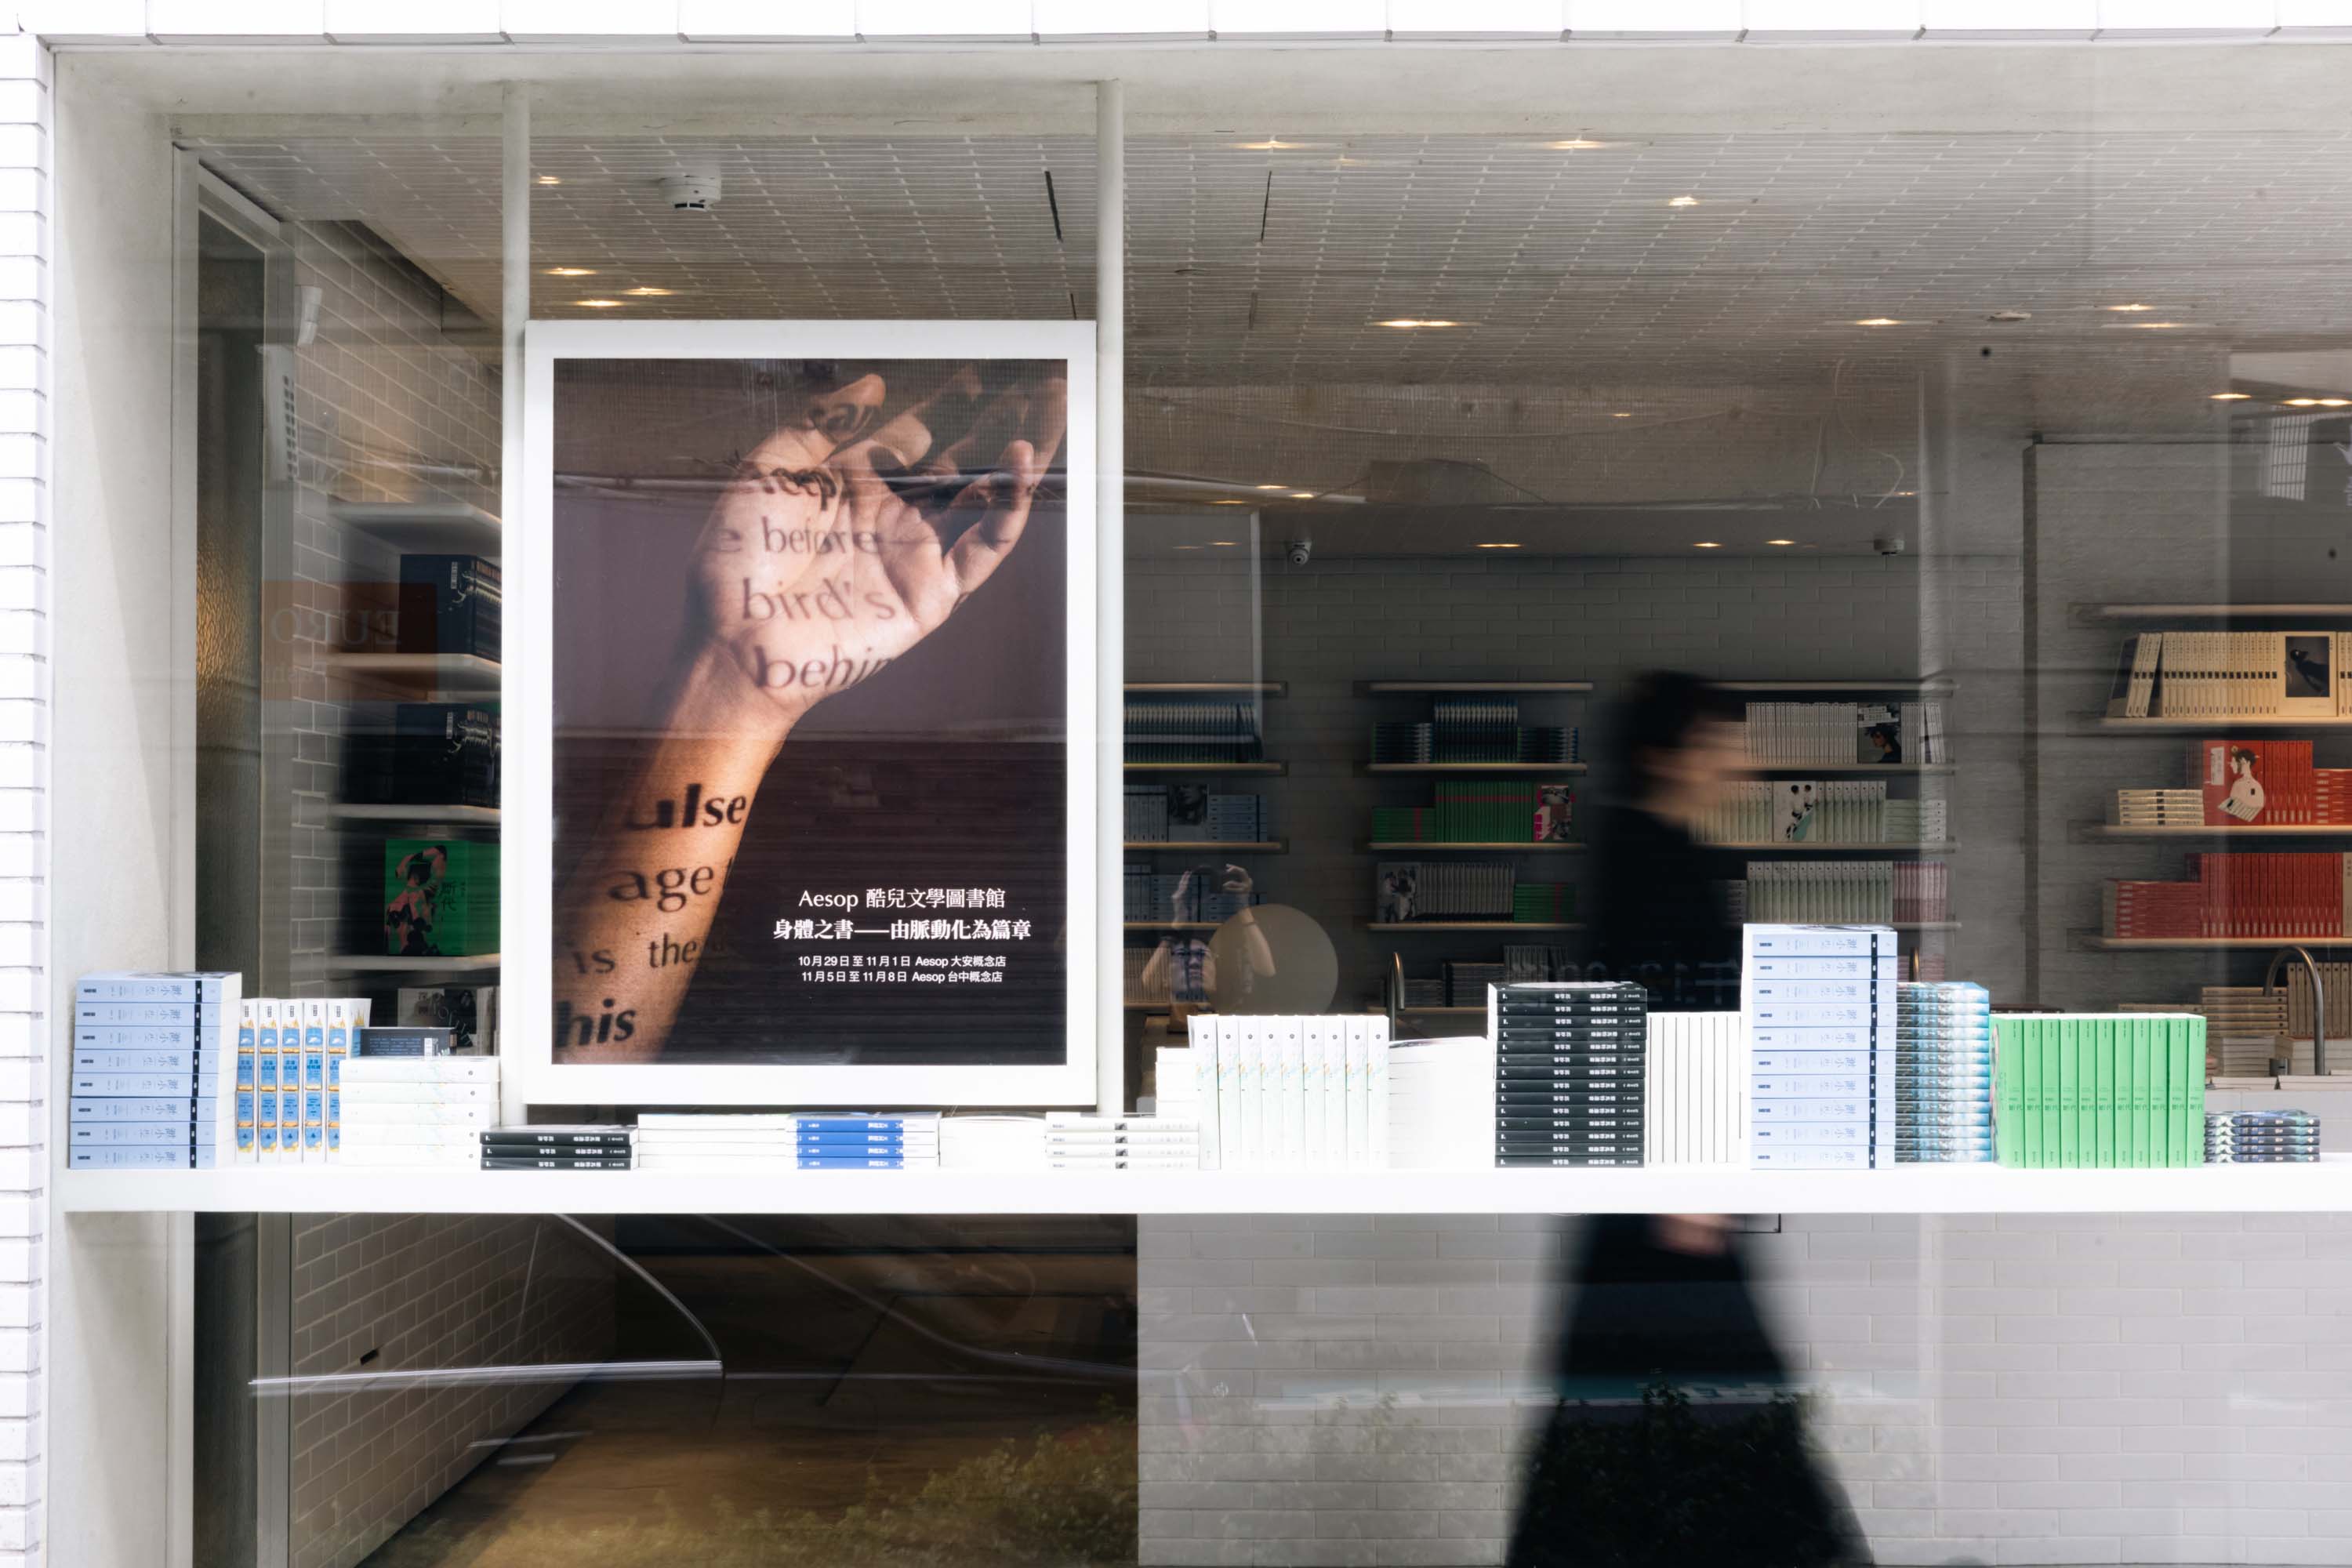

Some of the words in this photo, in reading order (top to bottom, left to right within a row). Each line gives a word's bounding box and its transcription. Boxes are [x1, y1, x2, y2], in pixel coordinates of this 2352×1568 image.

[762, 516, 881, 555] before
[742, 577, 897, 621] bird's
[798, 890, 859, 913] Aesop
[866, 887, 1006, 909] 酷兒文學圖書館
[648, 932, 698, 969] the
[852, 955, 864, 967] 至
[915, 956, 949, 969] Aesop
[951, 955, 1007, 968] 大安概念店
[849, 971, 860, 983] 至
[912, 972, 946, 985] Aesop
[948, 971, 1004, 984] 台中概念店
